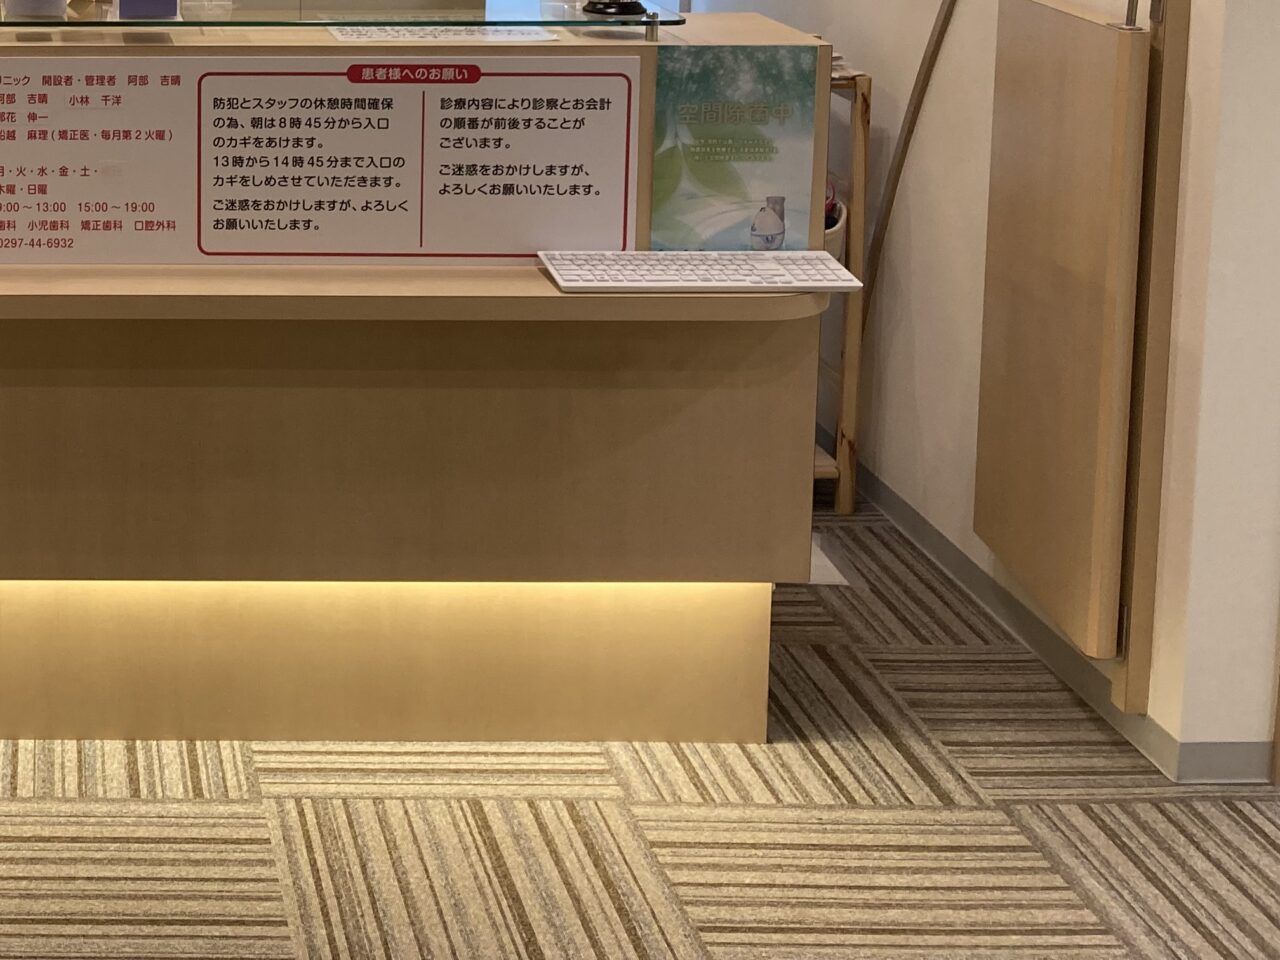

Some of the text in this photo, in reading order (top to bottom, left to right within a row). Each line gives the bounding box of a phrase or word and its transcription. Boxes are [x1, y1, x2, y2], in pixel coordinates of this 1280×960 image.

[41, 75, 116, 86] 開設者・管理者
[127, 75, 149, 86] 阿部
[160, 75, 181, 86] 吉晴
[361, 68, 468, 81] 患者様へのお願い
[27, 93, 48, 105] 吉晴
[69, 95, 90, 106] 小林
[101, 95, 122, 106] 千洋
[213, 97, 394, 111] 防犯とスタッフの休憩時間確保
[440, 97, 612, 111] 診療内容により診察とお会計
[27, 111, 49, 123] 伸一
[679, 102, 794, 126] 空間除菌中
[440, 117, 585, 130] の順番が前後することが
[213, 136, 324, 149] のカギをあけます。
[440, 137, 511, 150] ございます。
[439, 164, 590, 177] ご迷惑をおかけしますが、
[213, 175, 401, 188] カギをしめさせていただきます。
[439, 183, 601, 196] よろしくお願いいたします。
[213, 199, 409, 212] ご迷惑をおかけしますが、よろしく
[27, 220, 70, 231] 小児歯科
[80, 220, 123, 231] 矯正歯科
[134, 220, 176, 231] 口腔外科
[213, 218, 320, 231] お願いいたします。
